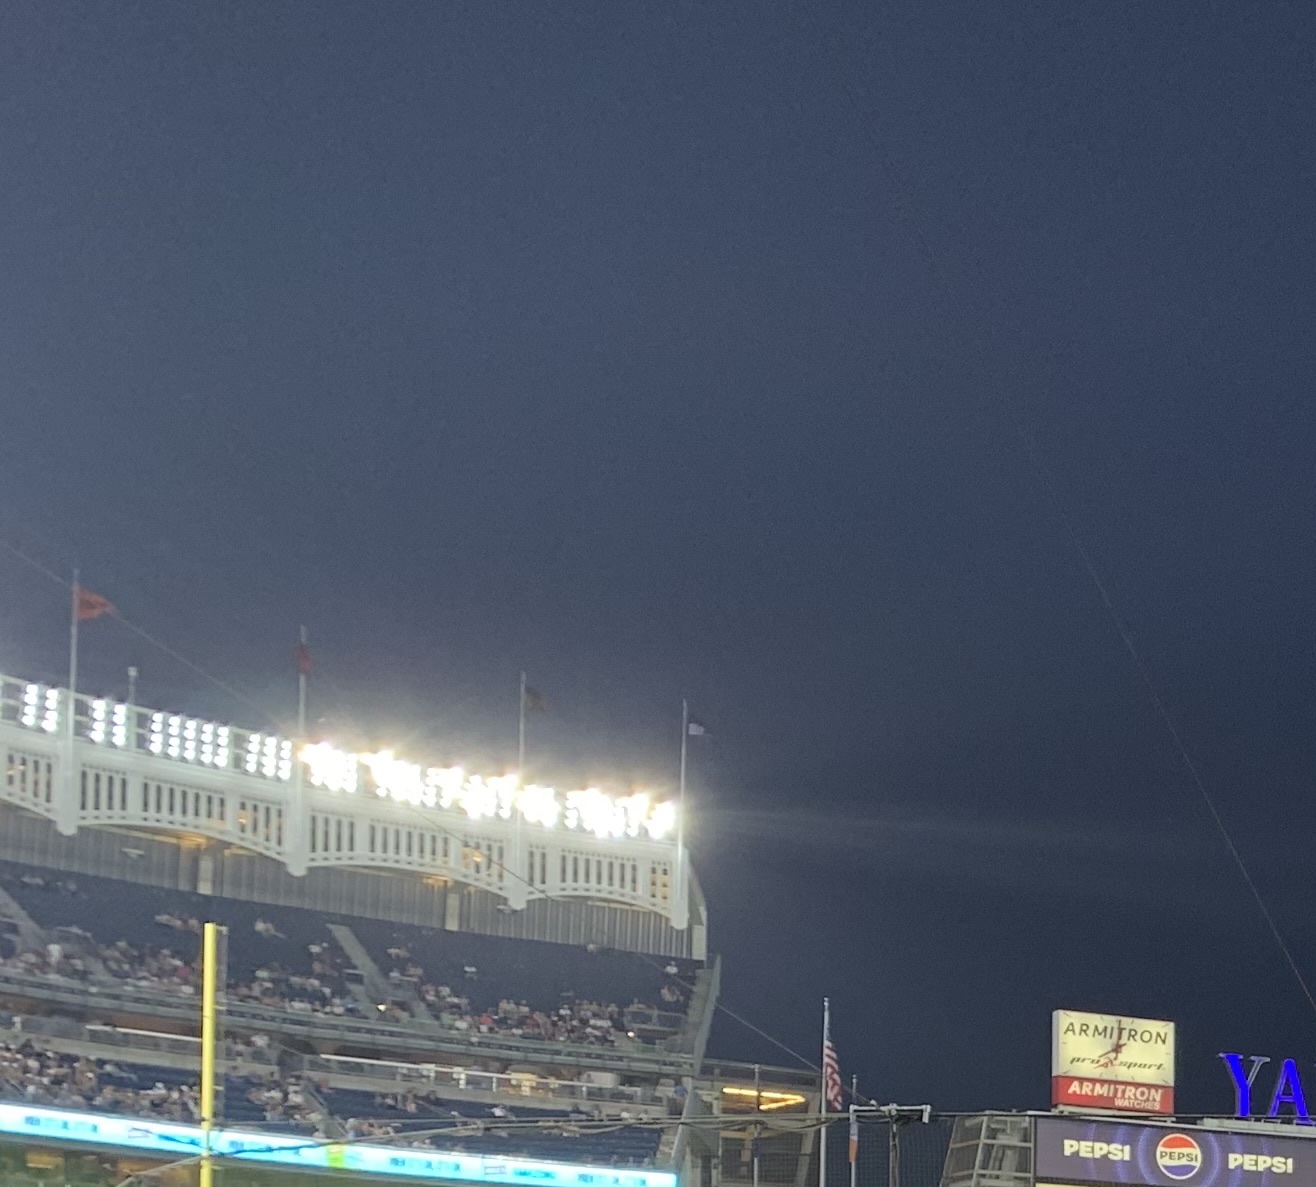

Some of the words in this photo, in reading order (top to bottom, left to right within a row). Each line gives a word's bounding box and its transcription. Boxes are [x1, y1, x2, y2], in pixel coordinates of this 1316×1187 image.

[1064, 1022, 1168, 1045] ARMITRON
[1068, 1080, 1162, 1101] ARMITRON
[1115, 1098, 1160, 1110] WATCHES
[1063, 1140, 1130, 1161] PEPSI
[1159, 1150, 1198, 1162] PEPSI
[1228, 1153, 1293, 1174] PEPSI
